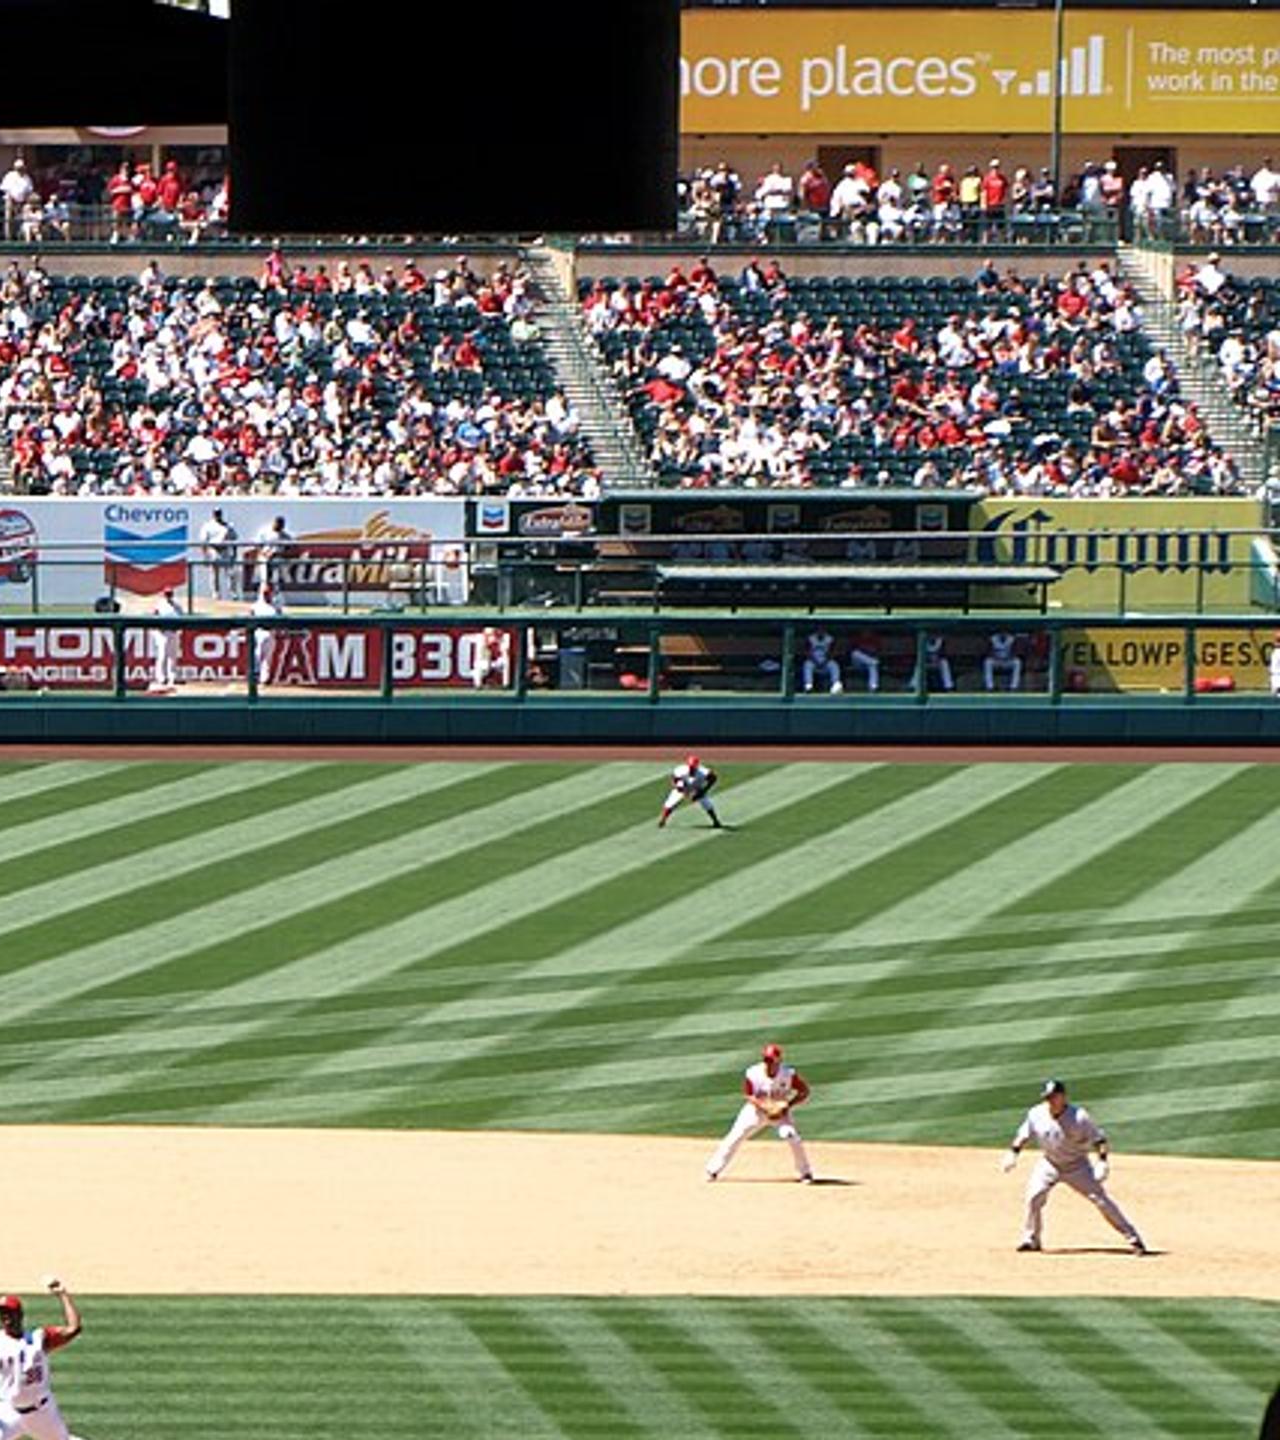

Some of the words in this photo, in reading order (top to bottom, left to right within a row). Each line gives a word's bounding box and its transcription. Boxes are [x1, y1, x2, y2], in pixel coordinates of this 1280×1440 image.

[1148, 42, 1189, 64] The
[1198, 44, 1255, 64] most
[801, 44, 977, 111] places
[1147, 69, 1204, 91] work
[1211, 69, 1233, 91] in
[1241, 68, 1278, 92] the
[104, 503, 190, 523] Chevron
[193, 628, 247, 659] of
[6, 665, 108, 682] NGELS
